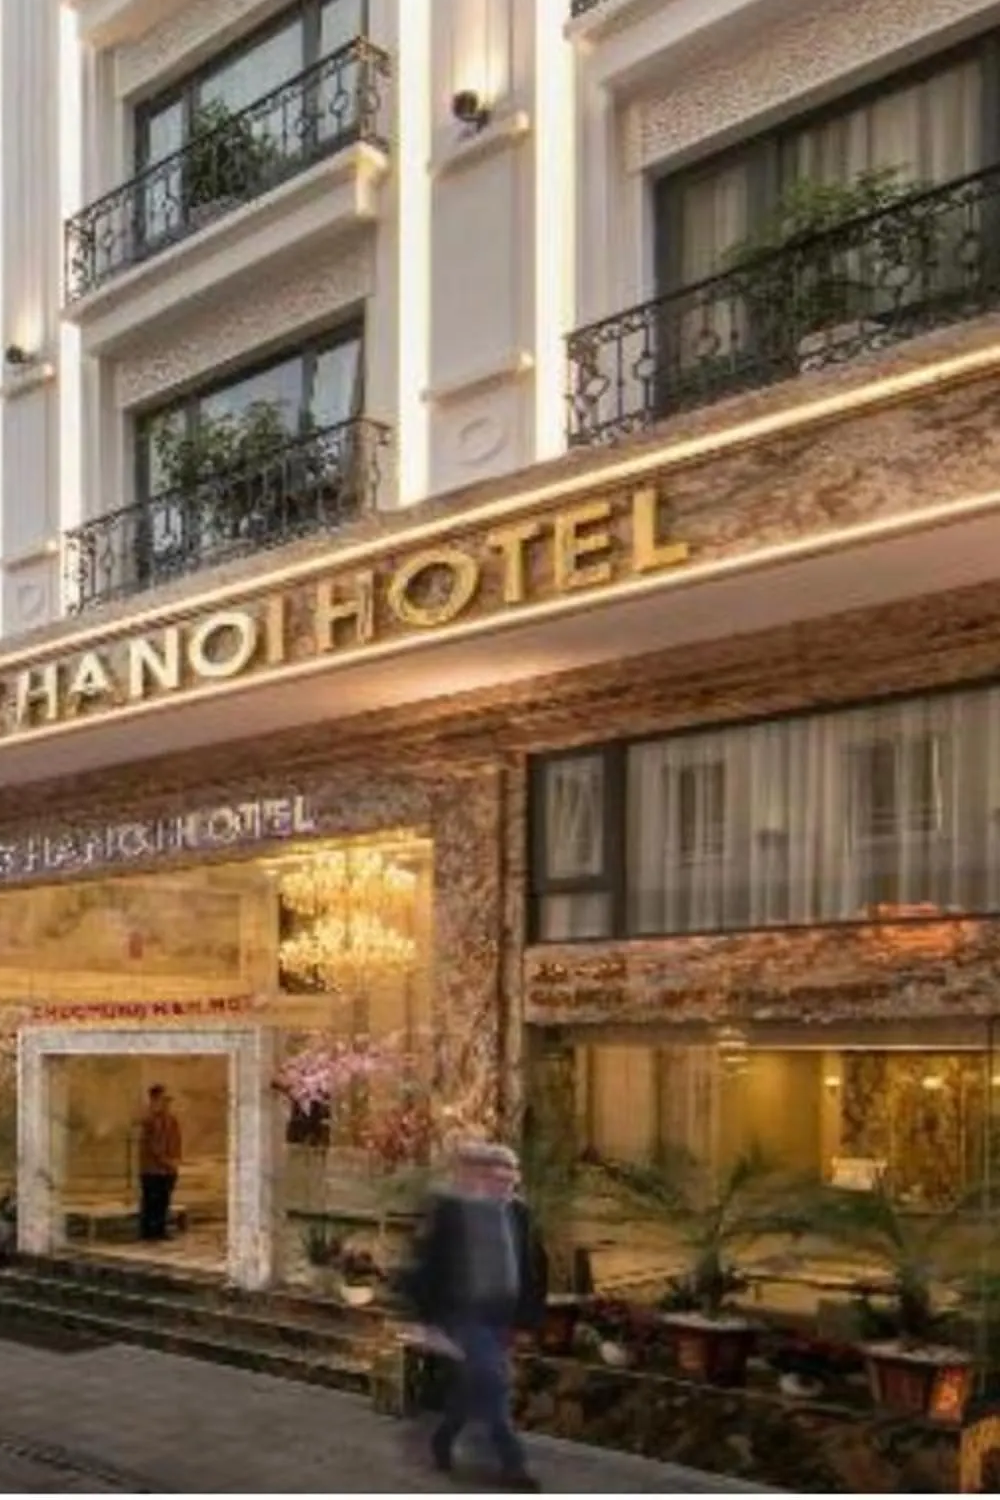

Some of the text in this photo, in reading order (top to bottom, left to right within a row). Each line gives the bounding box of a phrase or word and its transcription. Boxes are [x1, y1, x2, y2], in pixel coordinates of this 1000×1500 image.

[16, 595, 286, 726] HANOI
[314, 486, 689, 653] HOTEL
[174, 796, 315, 850] HOTEL
